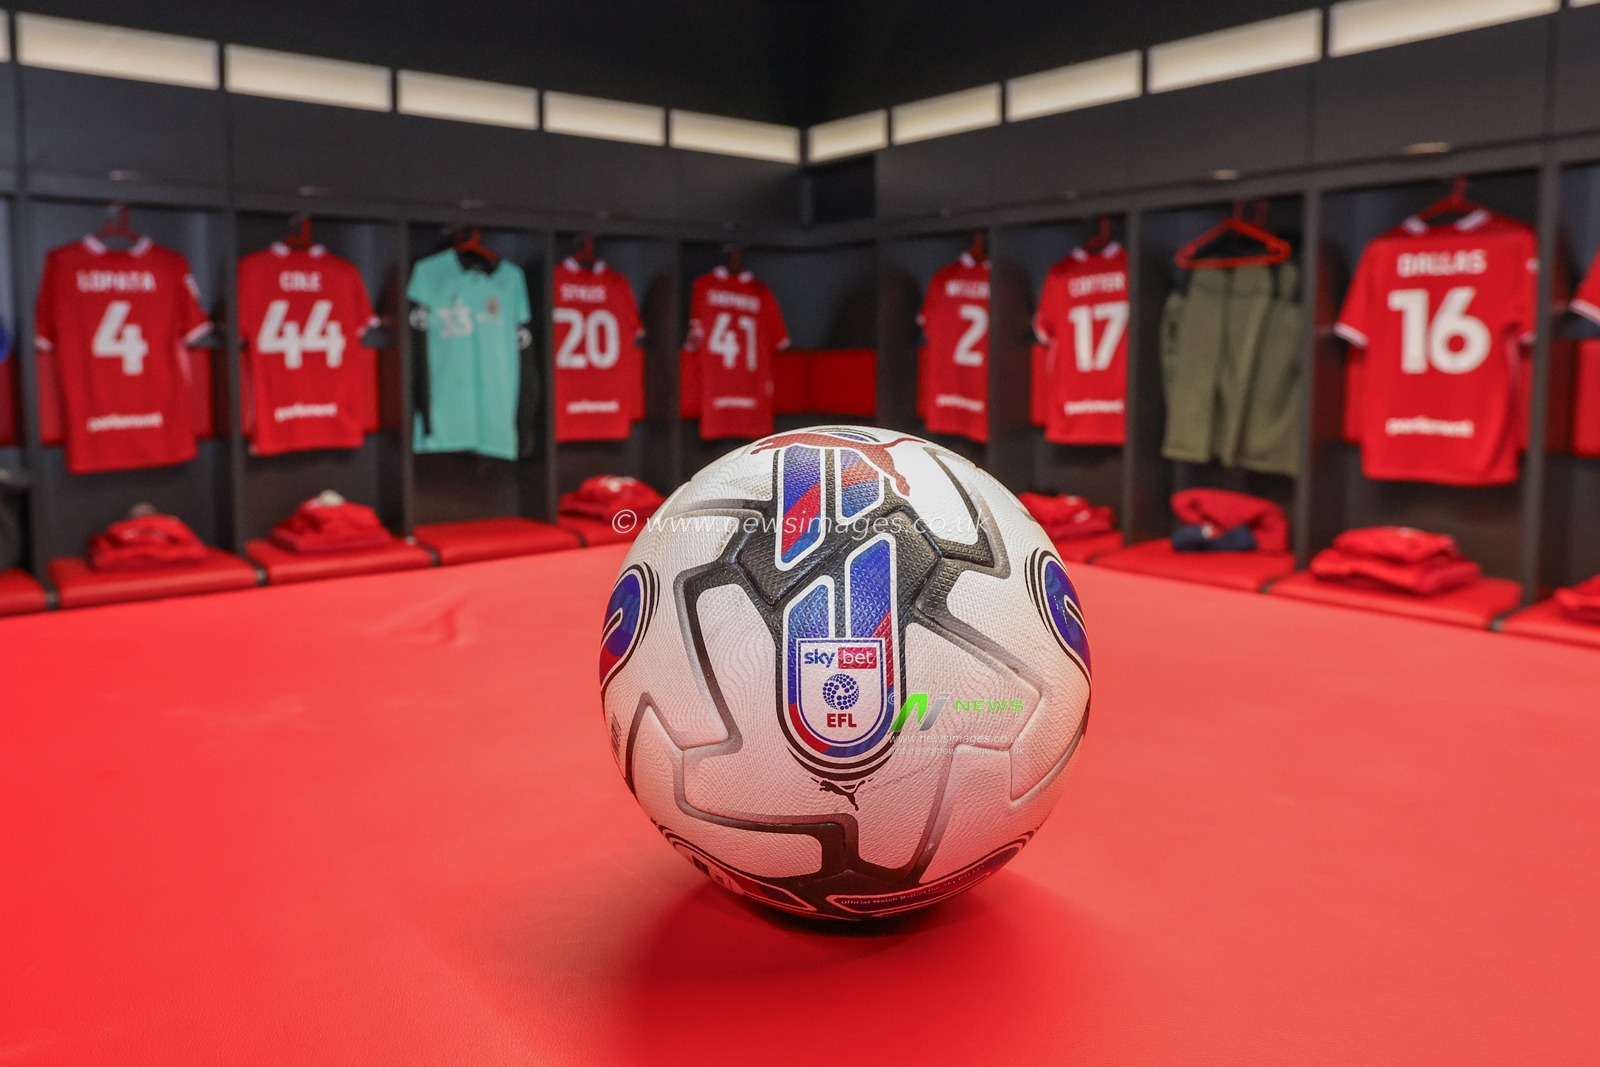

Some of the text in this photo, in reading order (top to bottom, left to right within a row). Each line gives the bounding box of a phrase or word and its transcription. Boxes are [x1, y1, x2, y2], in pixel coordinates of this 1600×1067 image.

[279, 271, 322, 292] COLE
[92, 300, 148, 375] 4
[257, 300, 346, 369] 44
[553, 308, 620, 369] 20
[708, 313, 757, 372] 41
[953, 304, 989, 367] 2
[1069, 301, 1129, 372] 17
[1387, 286, 1491, 374] 16
[804, 648, 875, 668] sky bet
[826, 713, 857, 728] EFL
